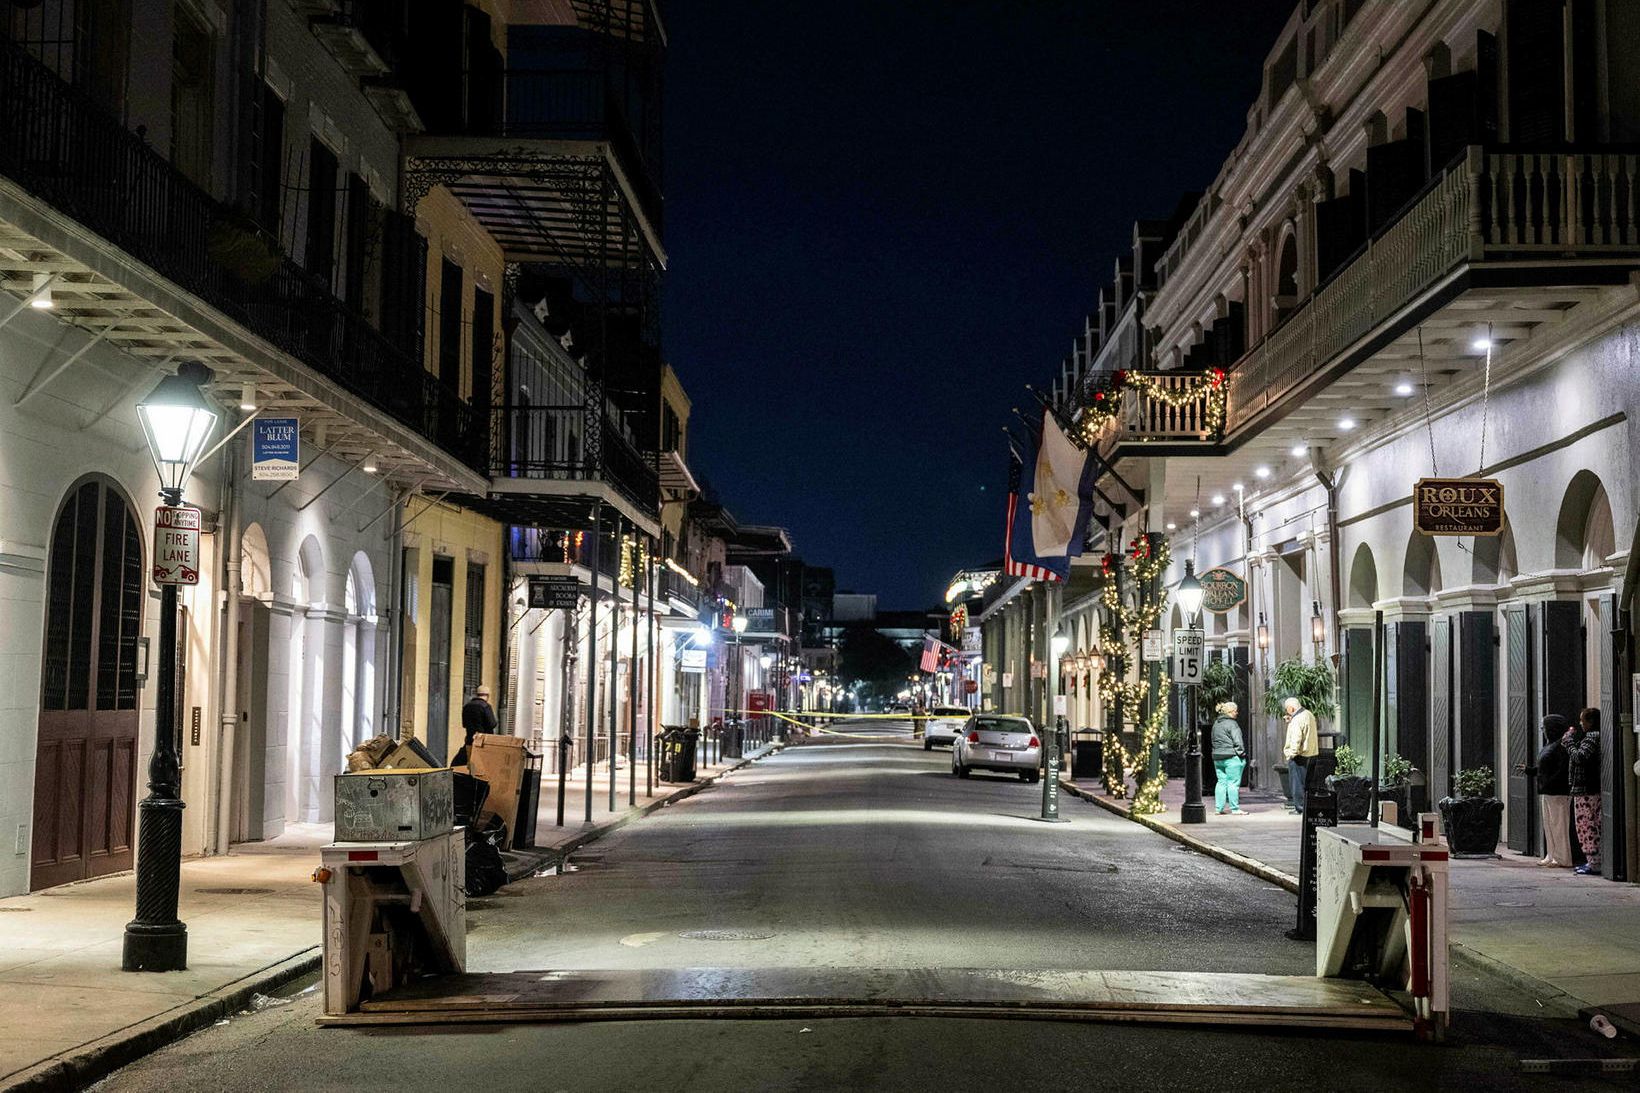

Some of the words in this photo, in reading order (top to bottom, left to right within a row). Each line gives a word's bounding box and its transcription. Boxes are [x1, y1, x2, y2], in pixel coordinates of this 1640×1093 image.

[260, 426, 295, 434] LATTER
[267, 433, 291, 441] BLUM
[1421, 487, 1497, 504] ROUX
[156, 509, 171, 526] NO
[1429, 503, 1490, 525] ORLEANS
[1435, 524, 1484, 532] RESTAURANT
[165, 532, 189, 546] FIRE
[163, 548, 190, 563] LANE
[1176, 635, 1202, 645] SPEED
[1179, 646, 1200, 656] LIMIT
[1179, 658, 1199, 678] 15
